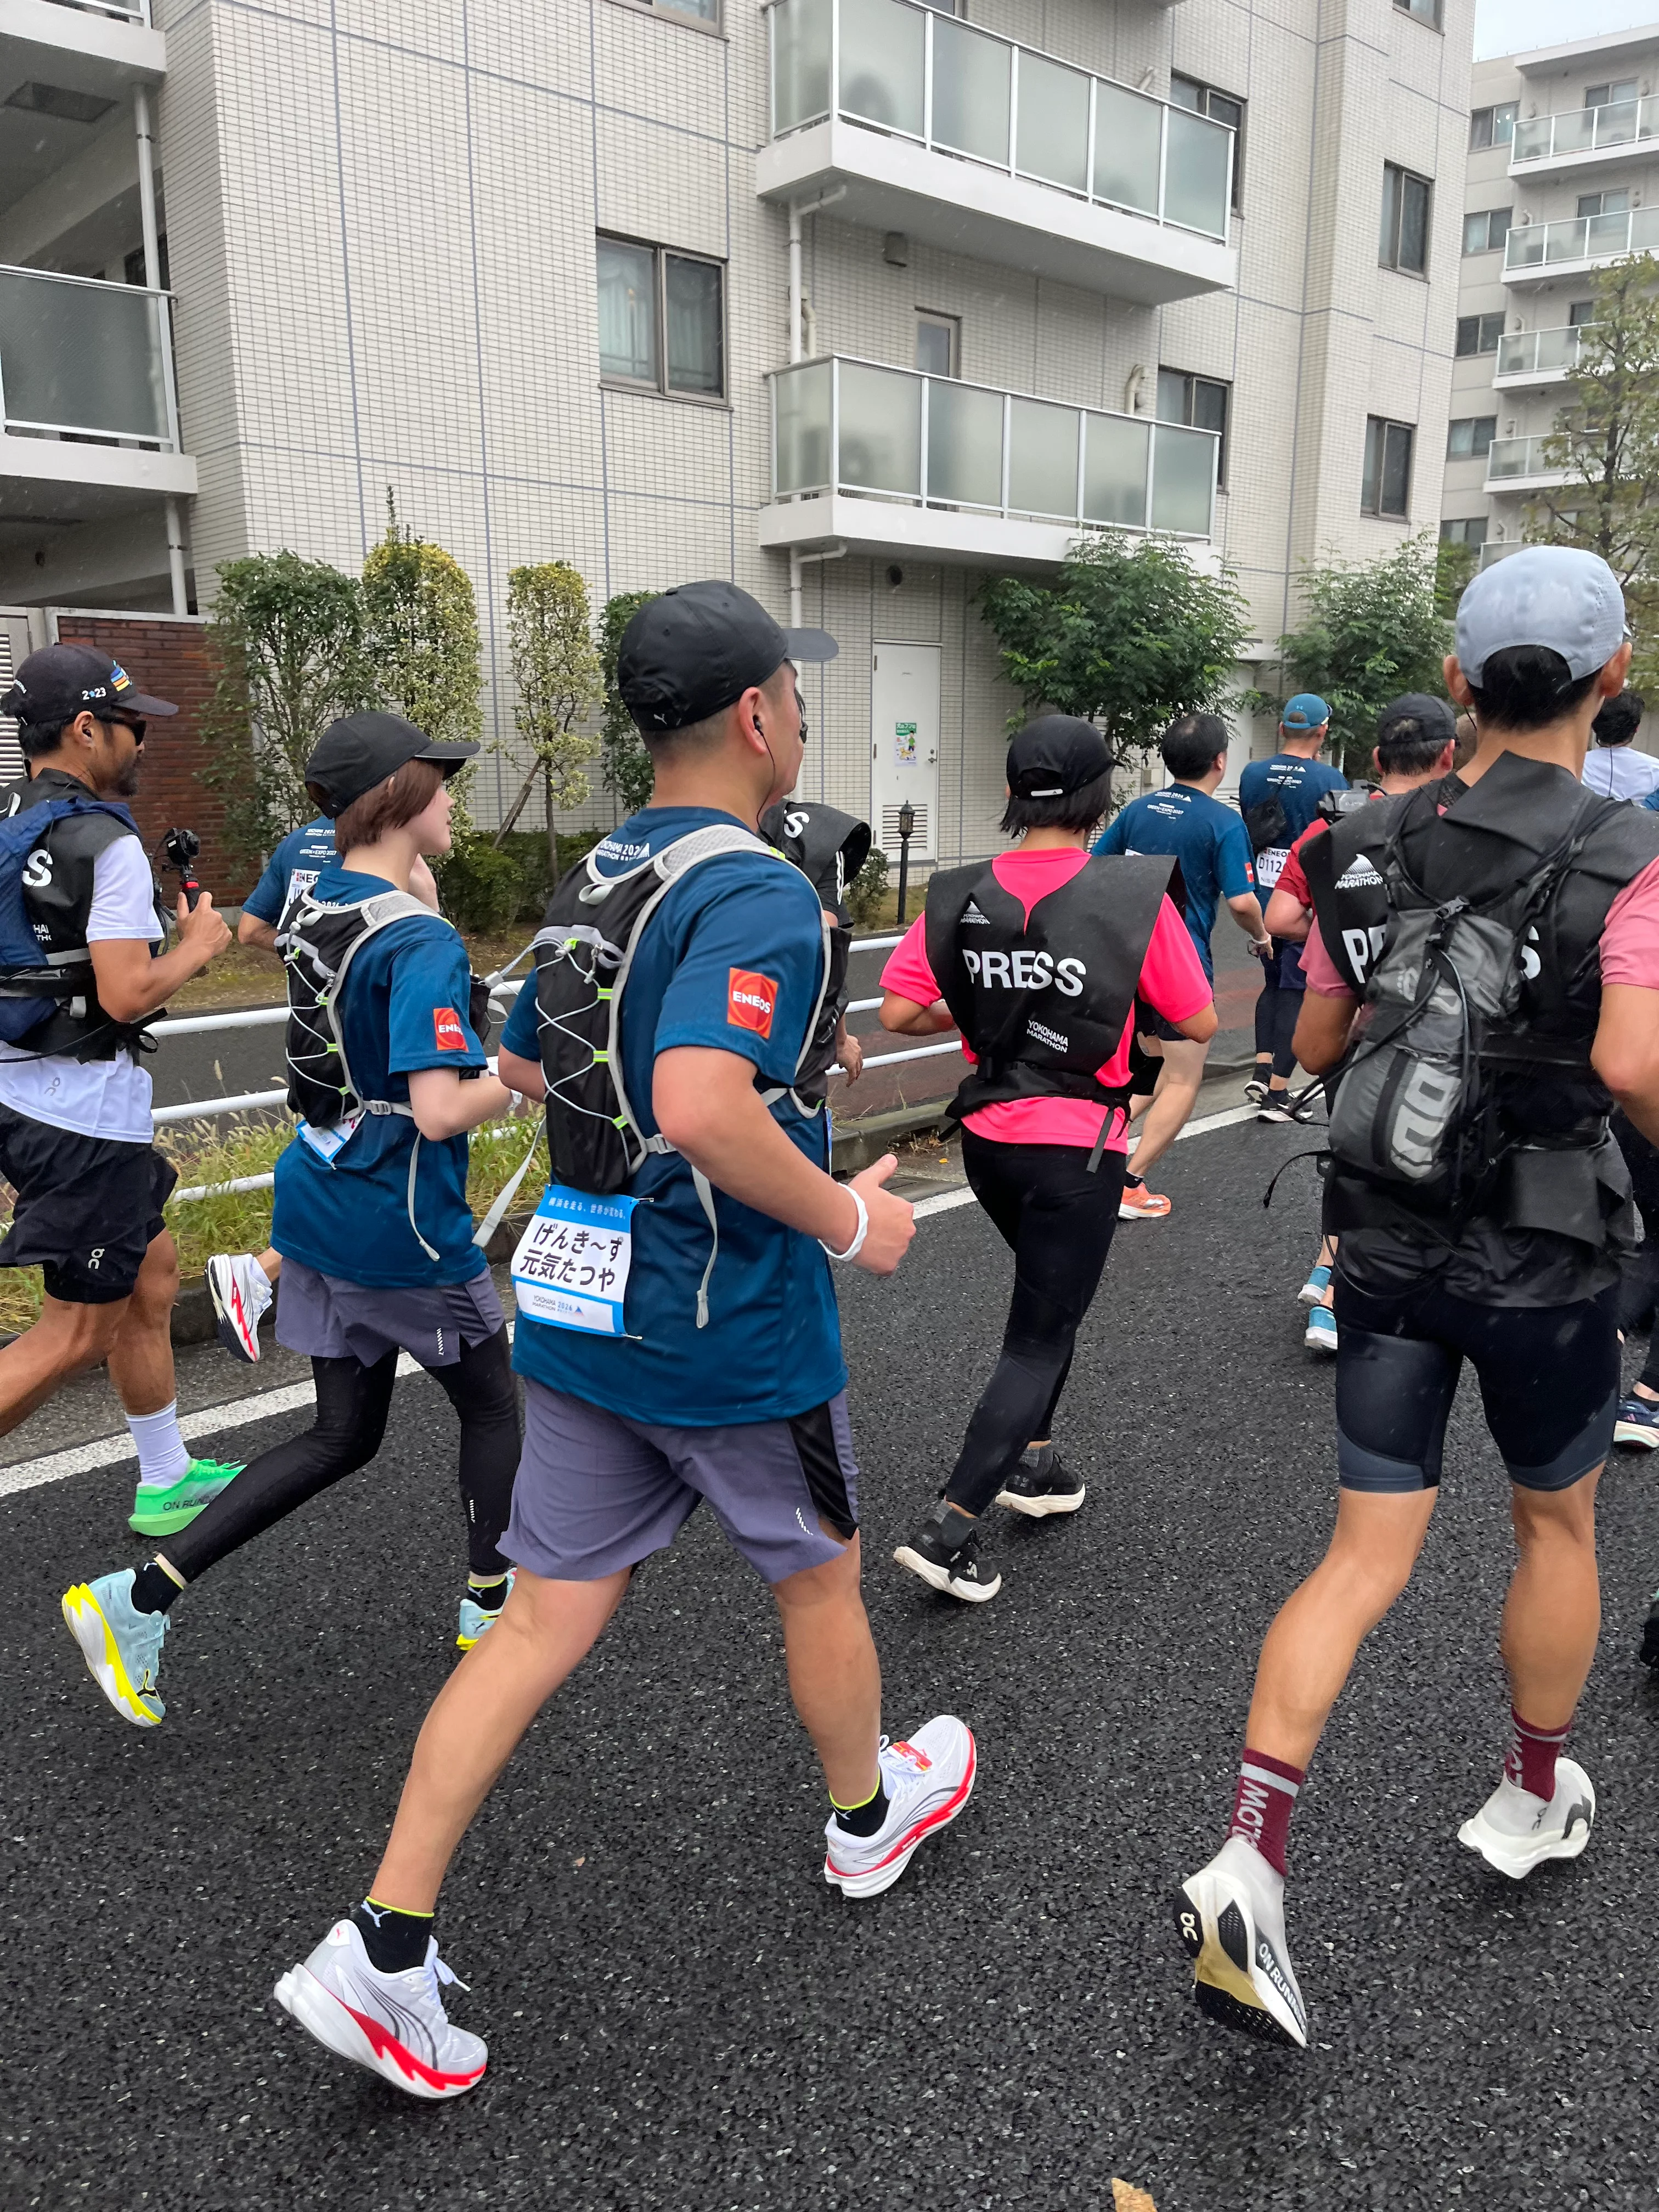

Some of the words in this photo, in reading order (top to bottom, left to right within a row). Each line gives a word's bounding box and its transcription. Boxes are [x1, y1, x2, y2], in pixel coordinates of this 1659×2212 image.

[622, 844, 641, 856] 202
[1267, 849, 1290, 857] ENEO
[1259, 856, 1282, 873] D112
[1334, 876, 1384, 890] MARATHON
[962, 949, 1087, 997] PRESS
[732, 990, 771, 1014] ENEOS
[1026, 1028, 1068, 1053] MARATHON
[1028, 1019, 1069, 1047] YOKOHAMA
[520, 1249, 616, 1292] 元気たつや
[557, 1301, 573, 1311] 2026
[162, 1501, 180, 1511] ON
[1232, 1779, 1269, 1849] LOW
[1259, 1943, 1275, 1971] ON
